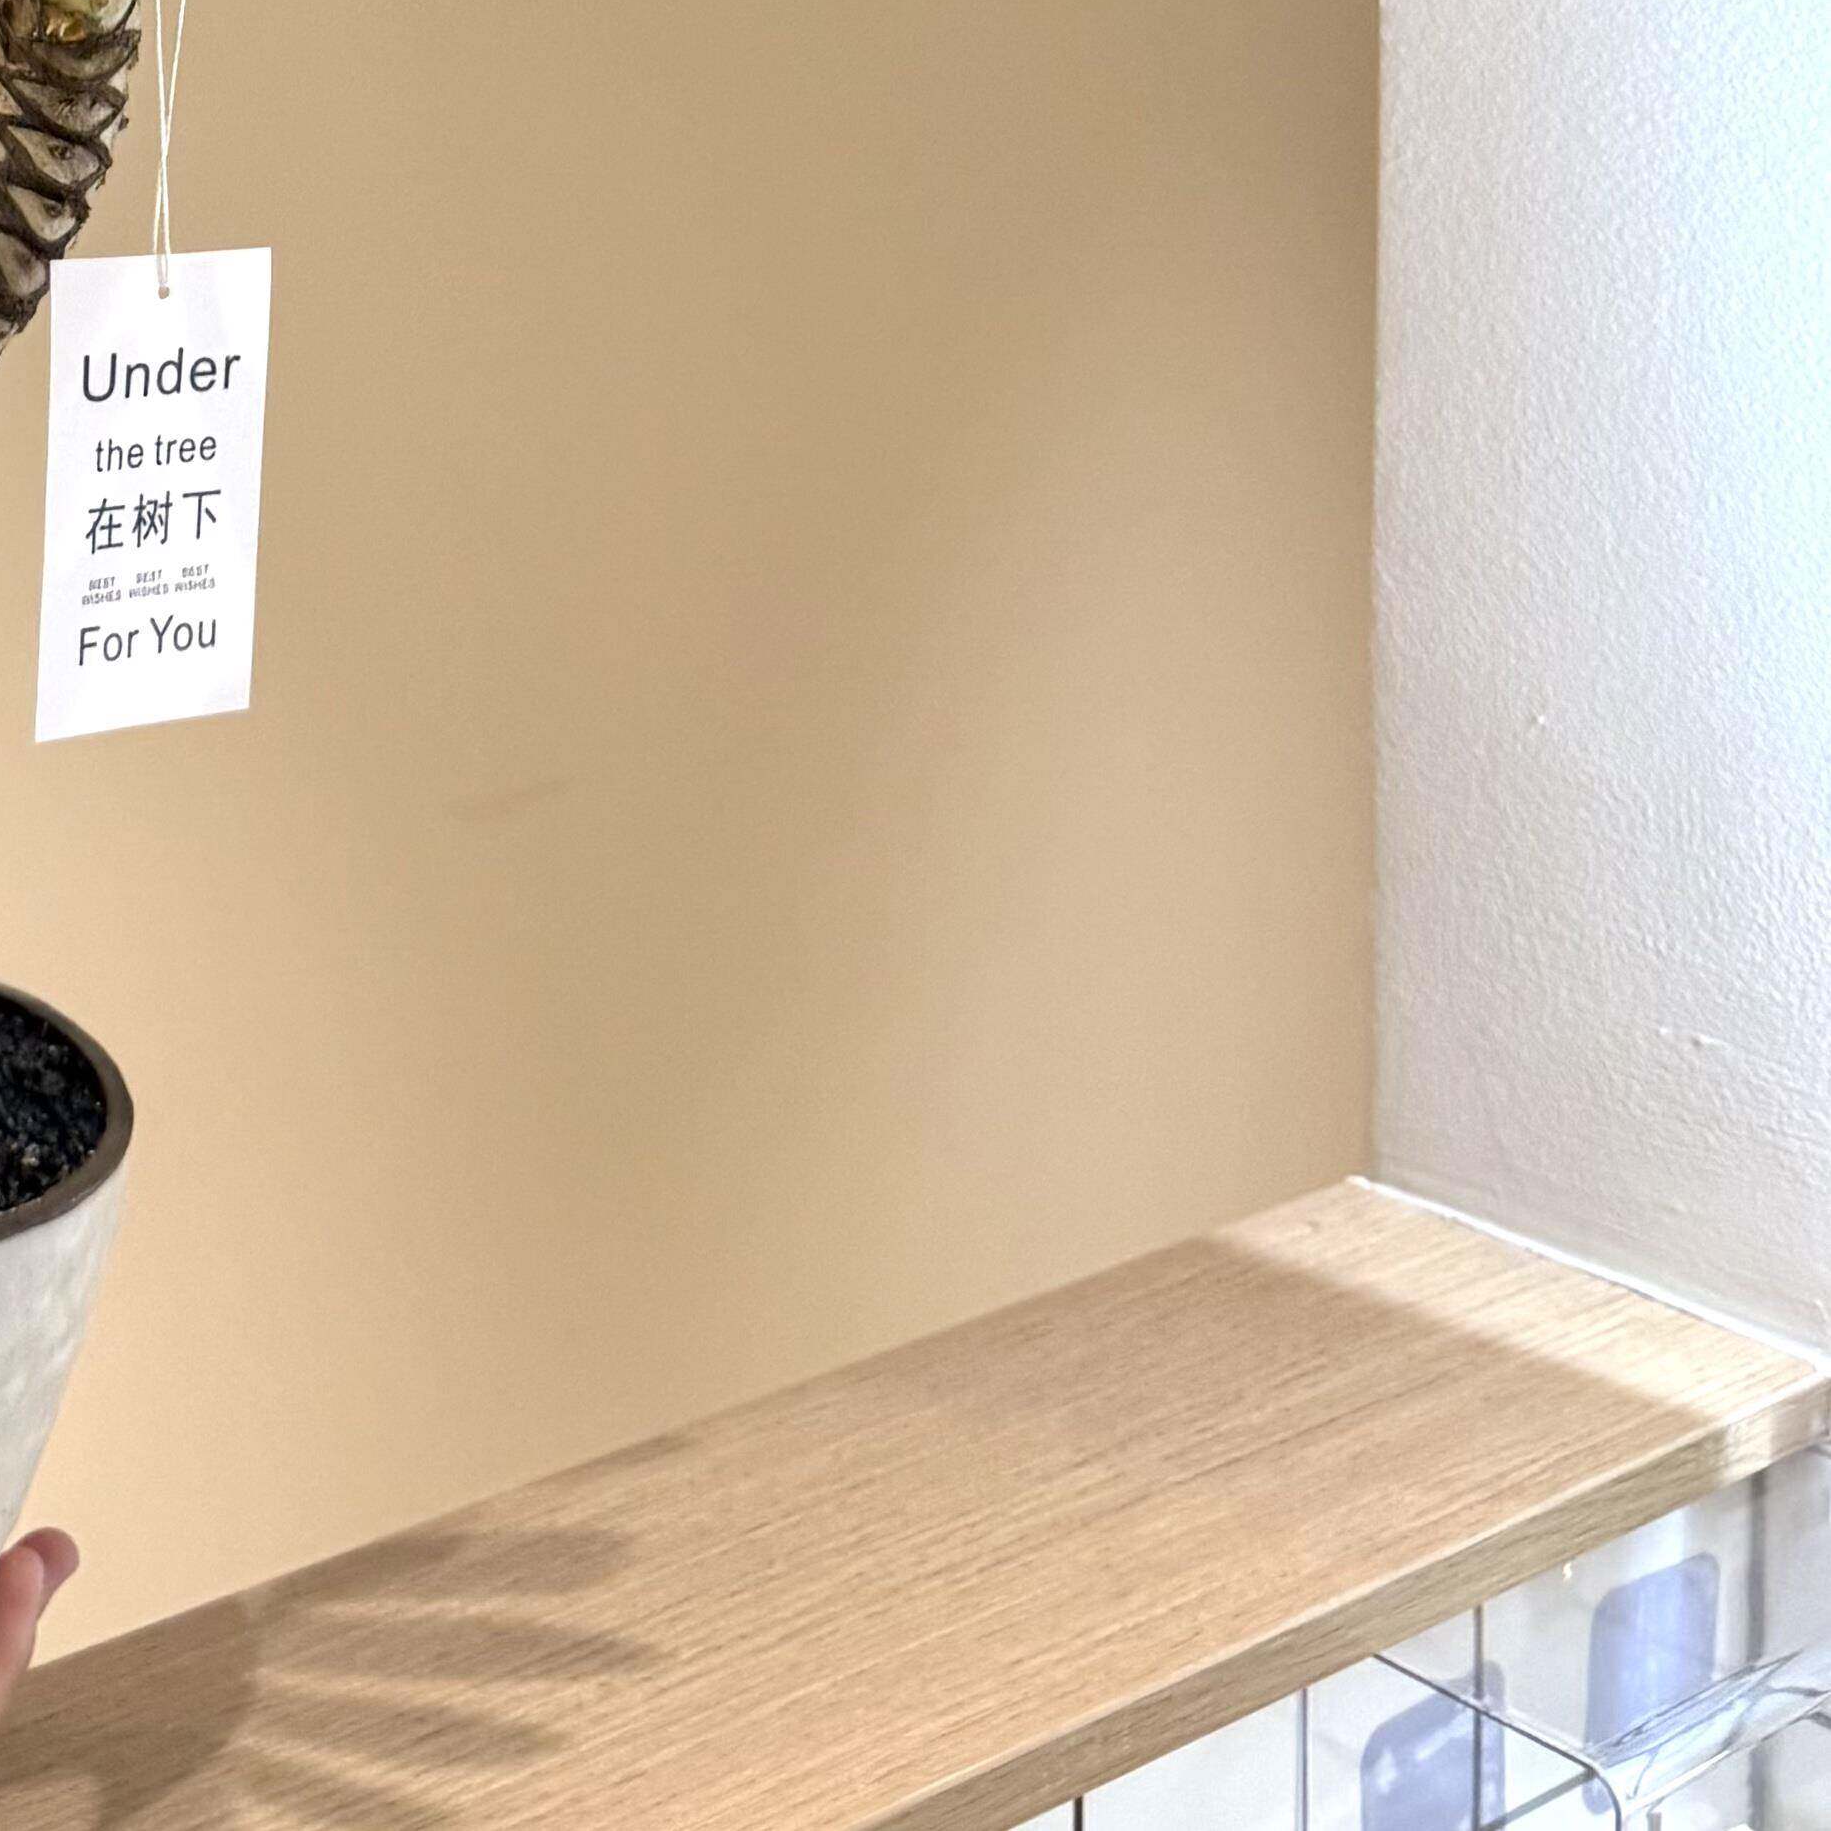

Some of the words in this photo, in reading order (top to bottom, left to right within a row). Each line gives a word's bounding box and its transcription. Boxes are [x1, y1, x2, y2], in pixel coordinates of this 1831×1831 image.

[82, 346, 241, 403] Under
[95, 438, 144, 473] the
[155, 434, 217, 467] tree
[85, 489, 222, 555] 在树下
[78, 625, 140, 667] For
[149, 614, 217, 654] You
